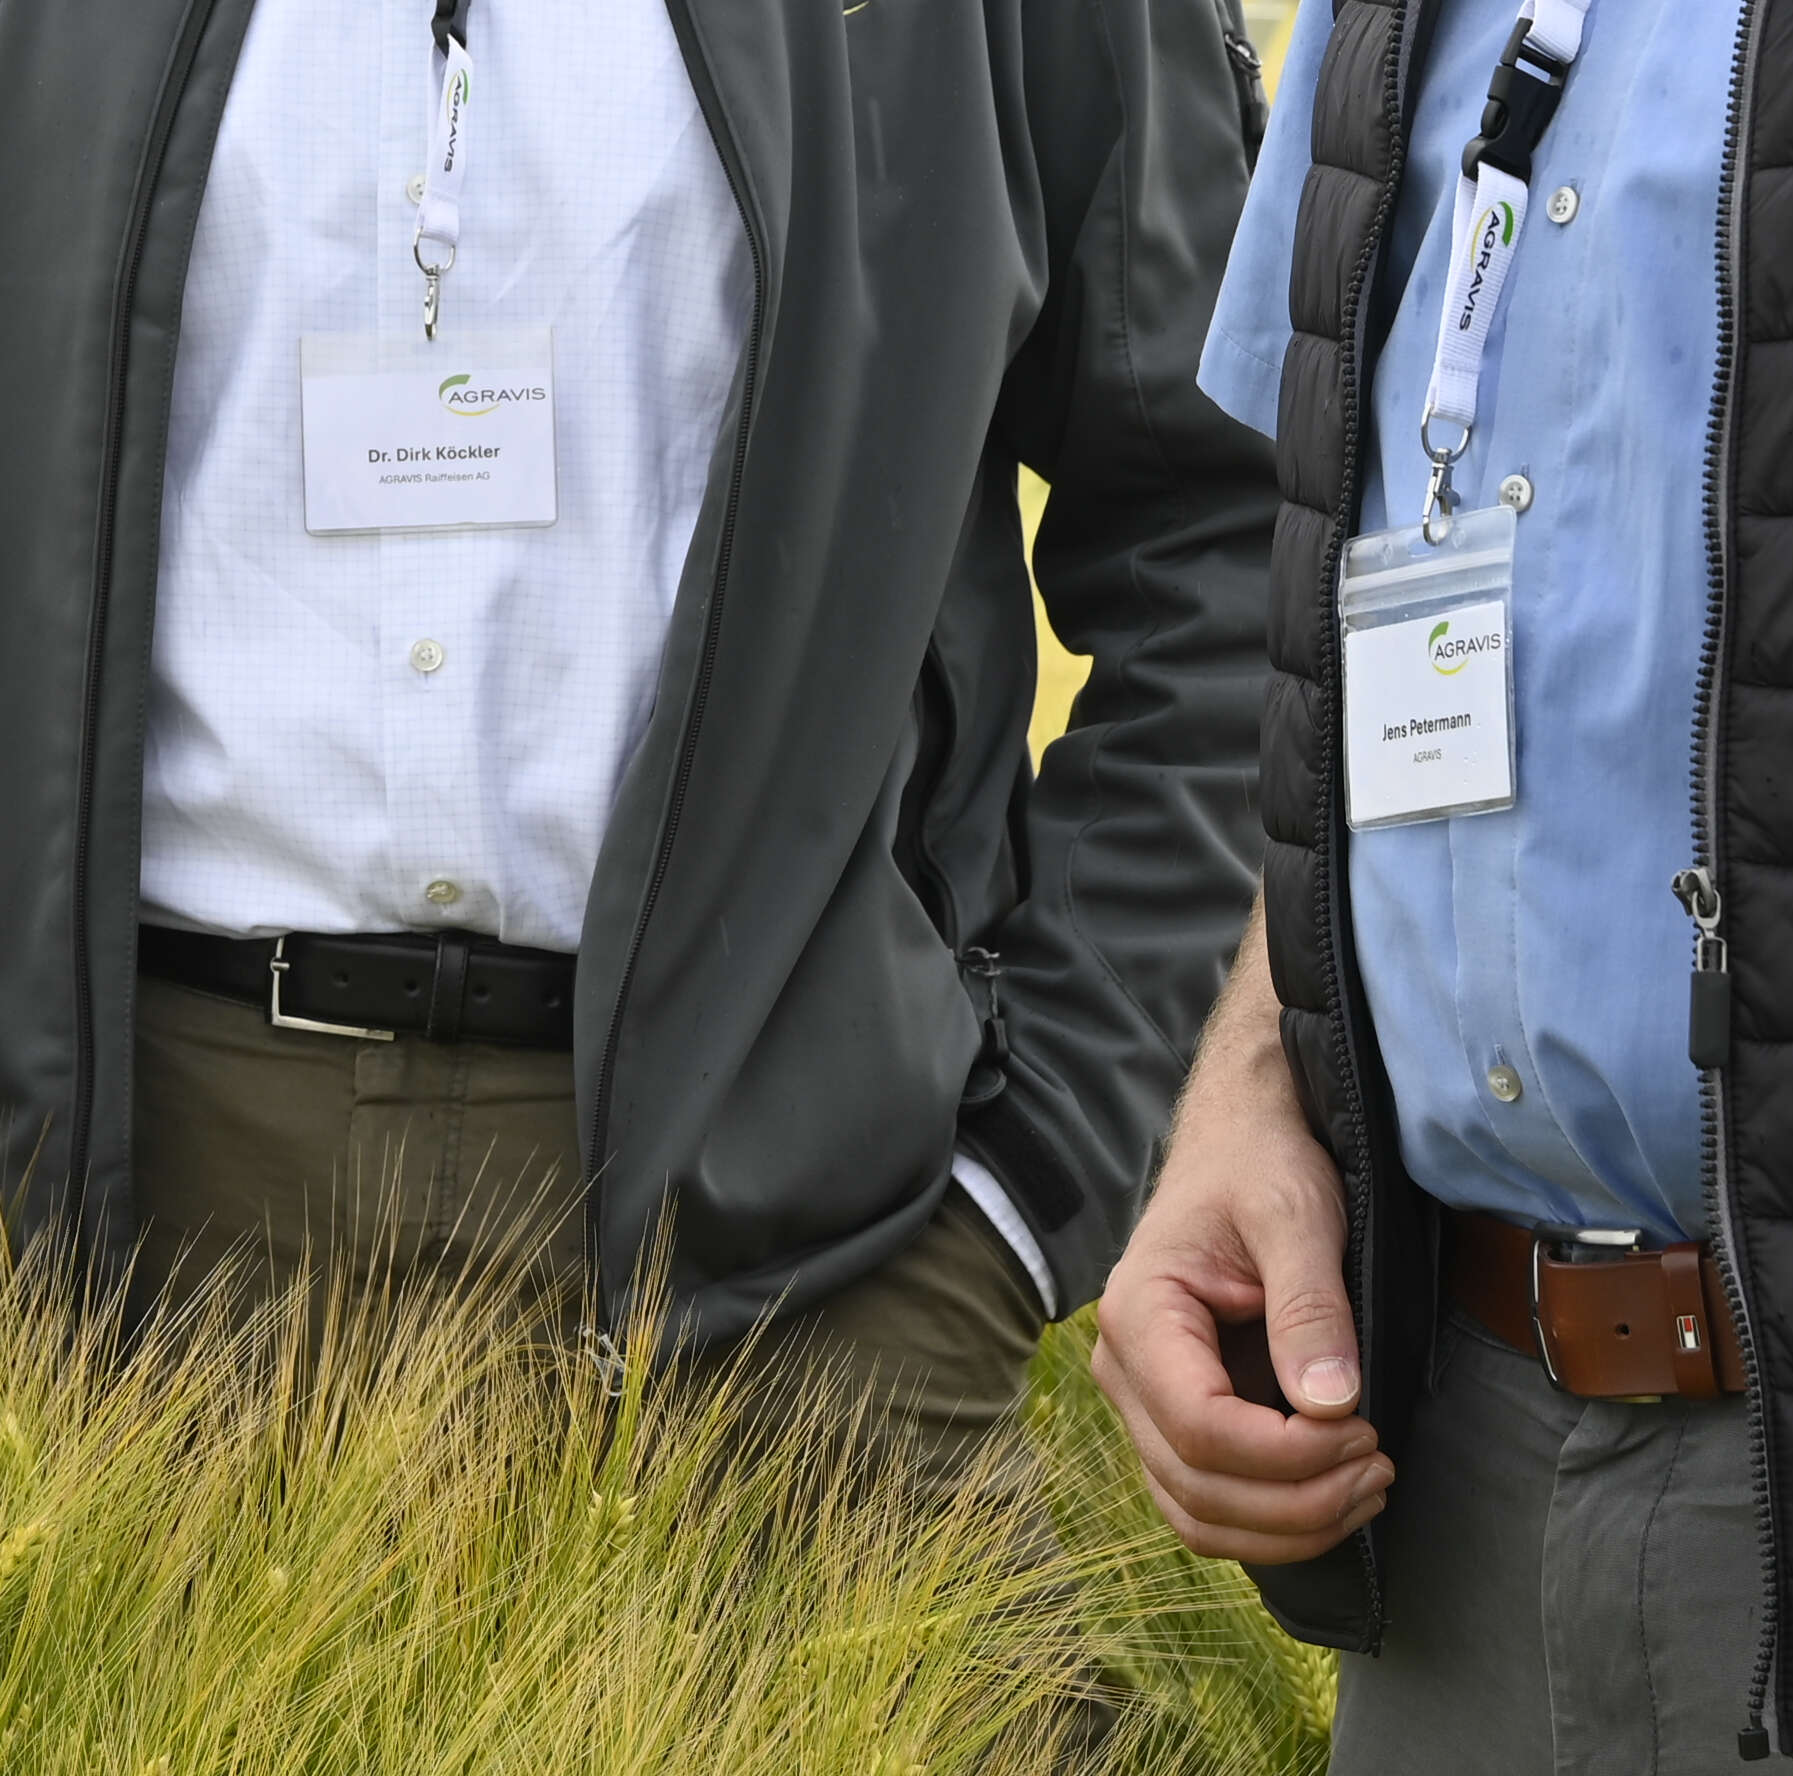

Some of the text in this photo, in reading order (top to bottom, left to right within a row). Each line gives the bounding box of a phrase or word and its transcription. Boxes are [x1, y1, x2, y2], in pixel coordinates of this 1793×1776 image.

[444, 75, 462, 172] AGRAVIS
[1459, 210, 1500, 331] AGRAVIS
[448, 387, 546, 404] AGRAVIS
[368, 445, 500, 463] Dr. Dirk Köckler
[379, 471, 490, 485] AGRAVIS Raiffeisen AG
[1434, 633, 1501, 660] AGRAVIS
[1382, 713, 1471, 742] Jens Petermann
